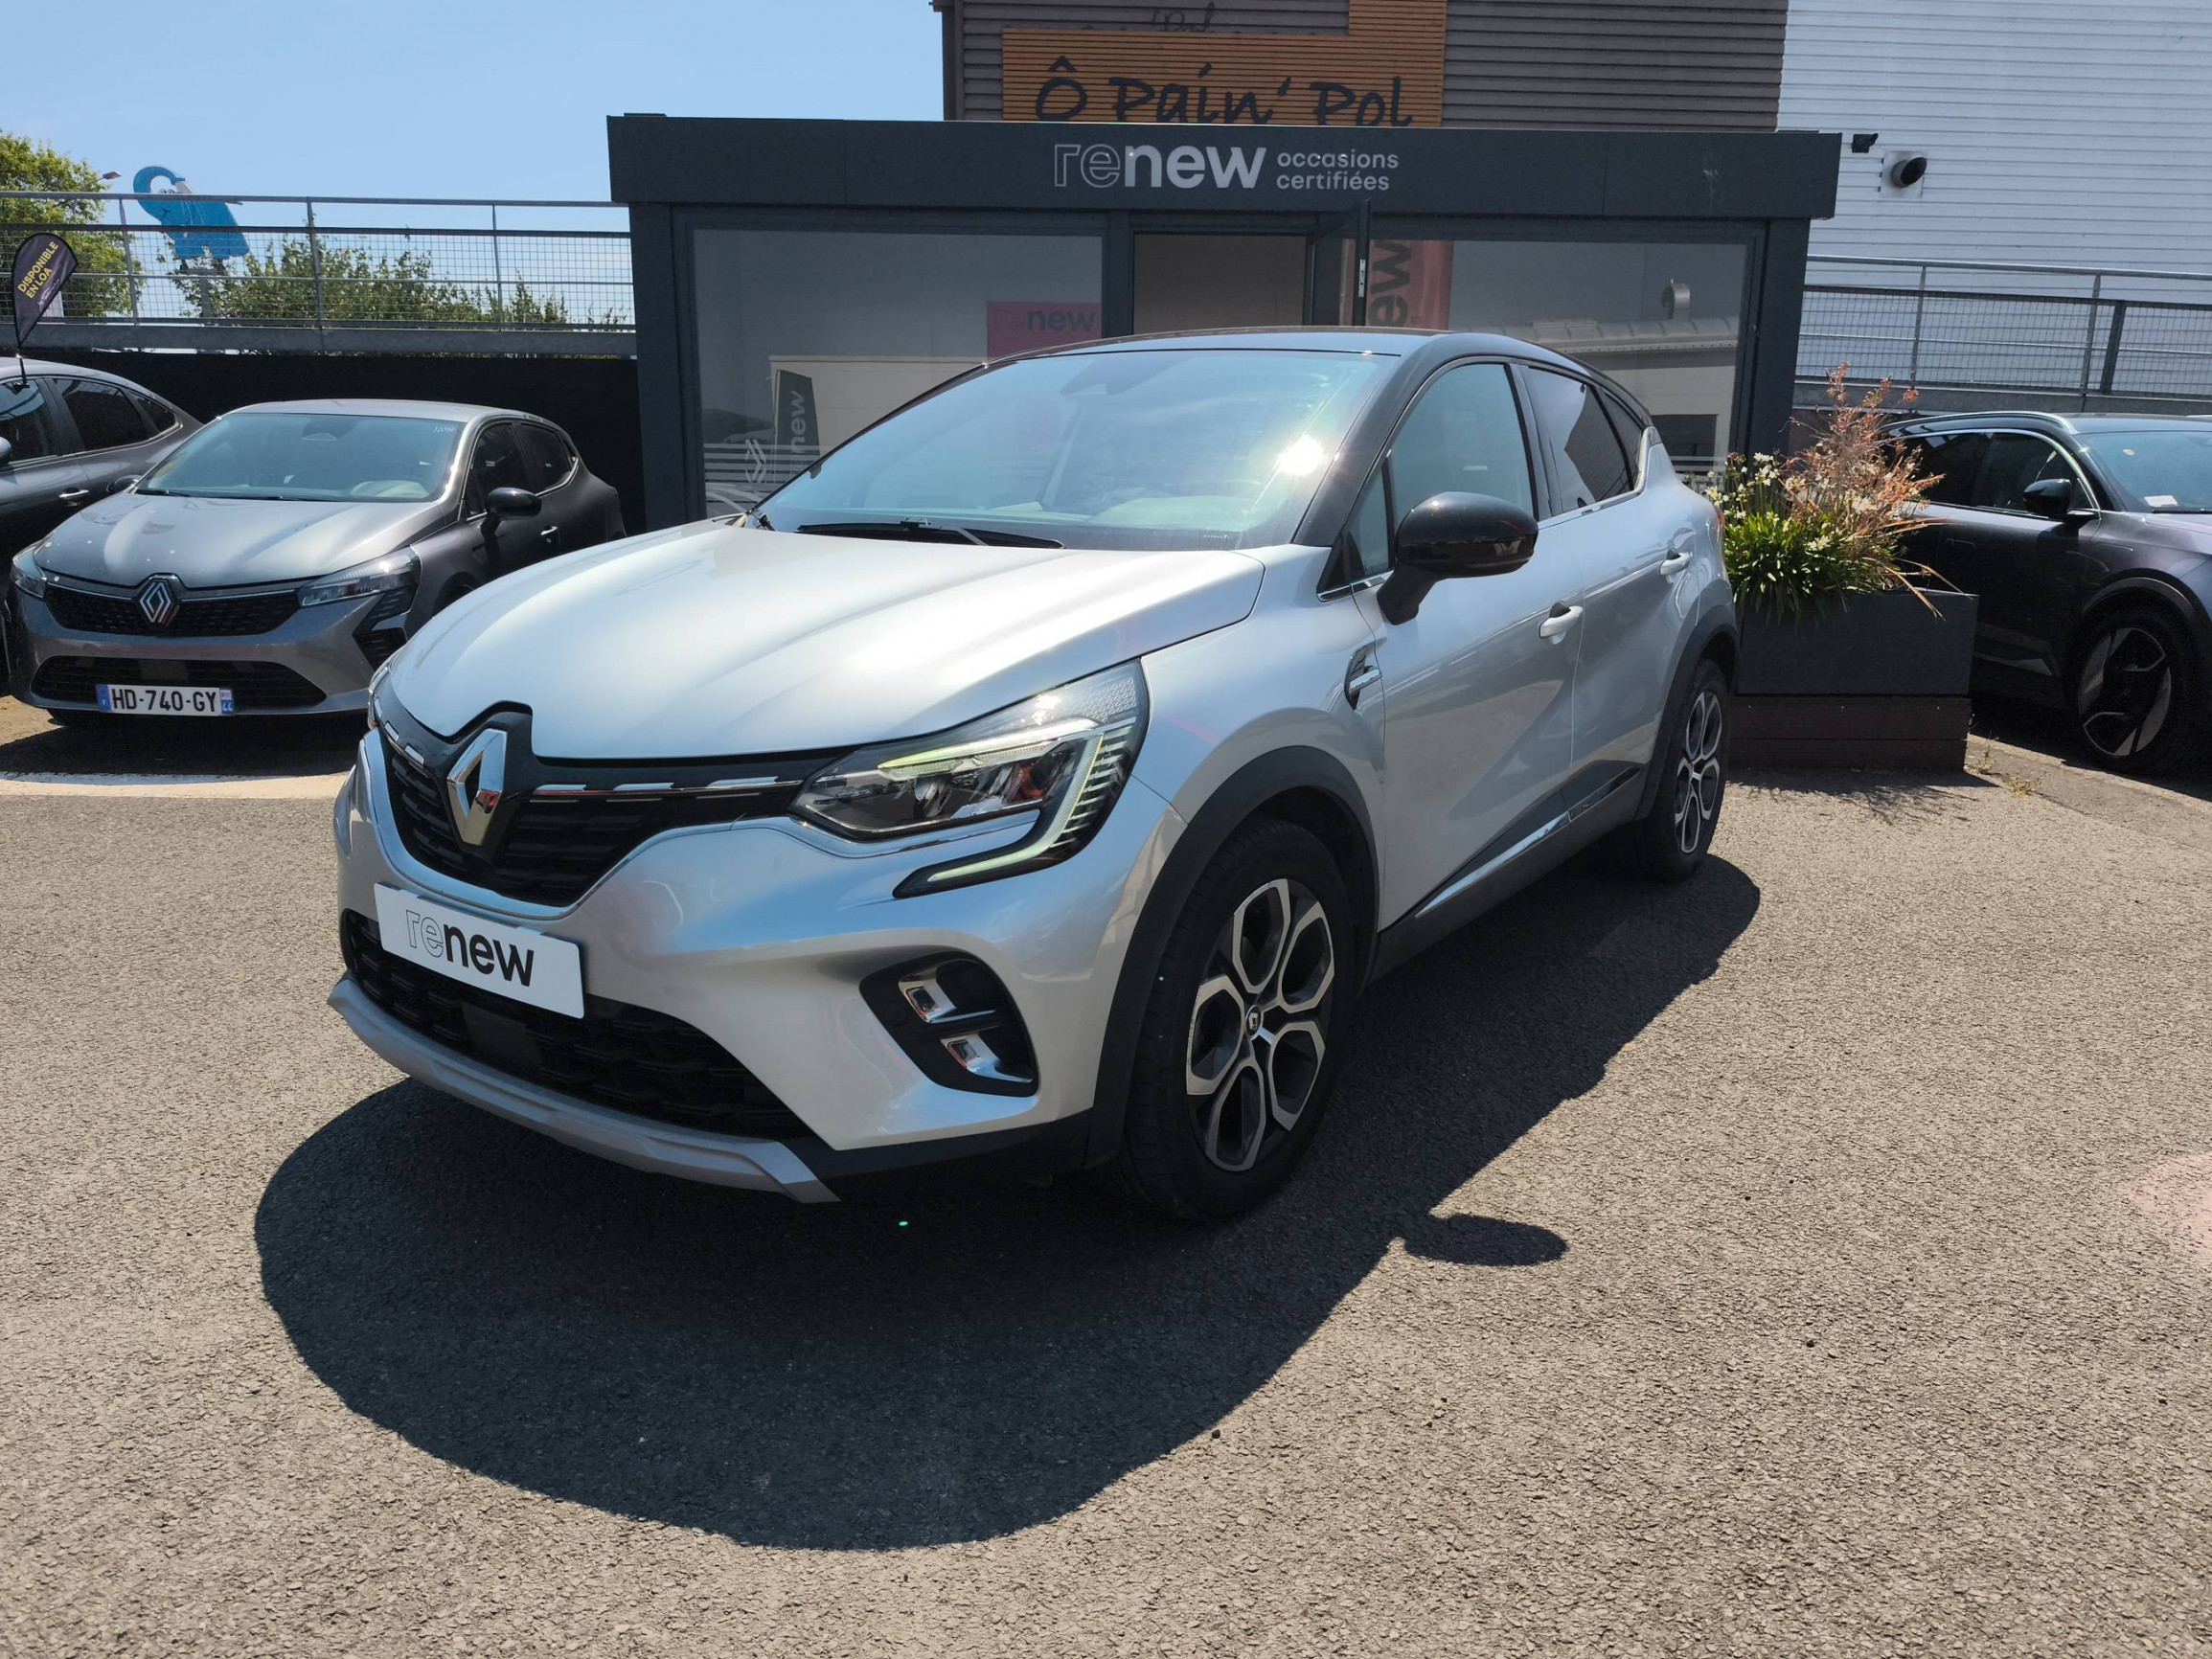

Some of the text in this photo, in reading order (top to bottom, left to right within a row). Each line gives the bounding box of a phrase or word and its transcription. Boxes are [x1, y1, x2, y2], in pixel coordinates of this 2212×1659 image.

[1036, 56, 1088, 121] Ô
[1311, 76, 1414, 126] Pol
[1055, 144, 1267, 189] renew
[1277, 148, 1399, 169] occasions
[1276, 170, 1390, 191] certifiées
[17, 241, 58, 293] DISPONIBLE
[25, 285, 39, 299] EN
[34, 268, 53, 286] LOA
[112, 689, 217, 712] HD-740-GY
[406, 909, 535, 988] renew
